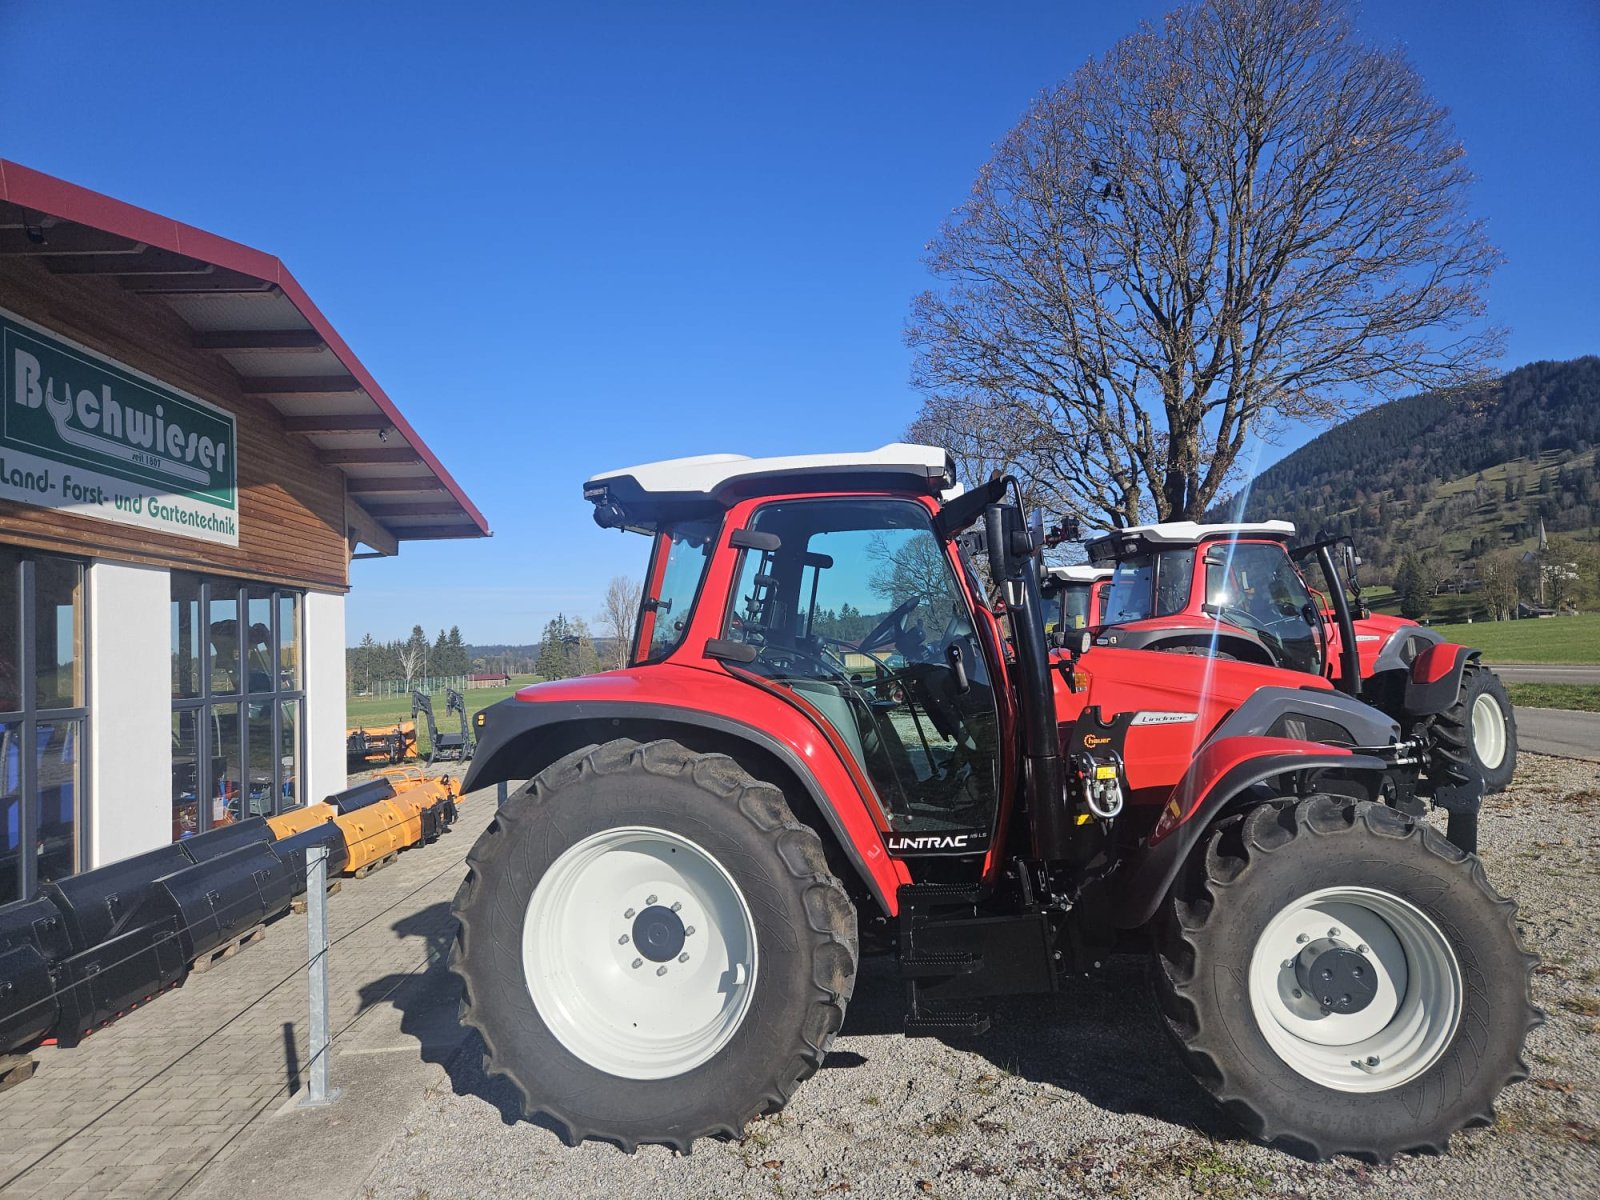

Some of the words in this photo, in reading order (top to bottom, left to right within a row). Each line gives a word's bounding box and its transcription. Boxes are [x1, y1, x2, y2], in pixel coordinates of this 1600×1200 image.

[15, 348, 226, 473] Buchwieser
[0, 458, 56, 493] Land-
[62, 475, 109, 505] Forst-
[114, 494, 143, 514] und
[147, 496, 235, 536] Gartentechnik
[888, 835, 968, 849] LINTRAC
